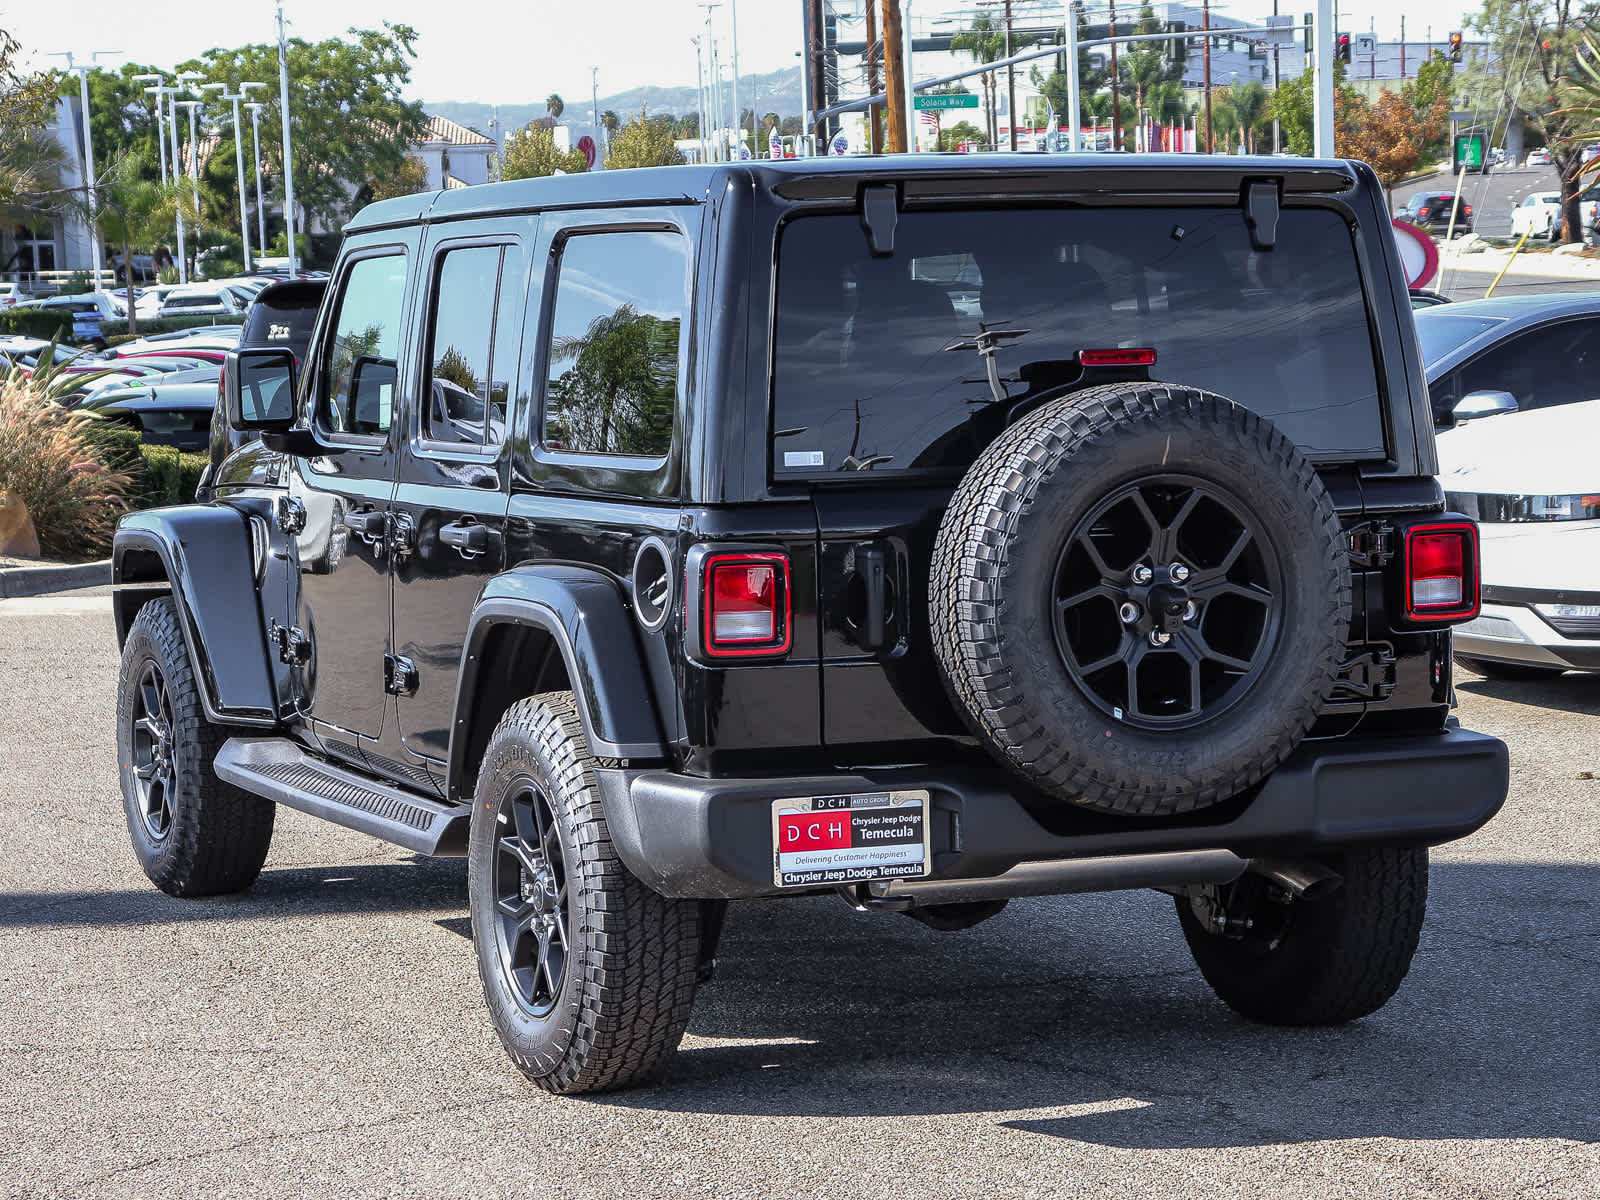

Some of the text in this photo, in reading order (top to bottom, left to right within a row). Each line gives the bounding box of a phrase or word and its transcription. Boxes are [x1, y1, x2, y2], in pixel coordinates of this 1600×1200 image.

[920, 98, 965, 107] Solana Way
[851, 814, 921, 827] Chrysler Jeep Dodge
[860, 825, 914, 839] Temecula
[795, 851, 907, 865] Delivering Customer Happiness
[784, 864, 922, 883] Chrysler Jeep Dodge Temecula
